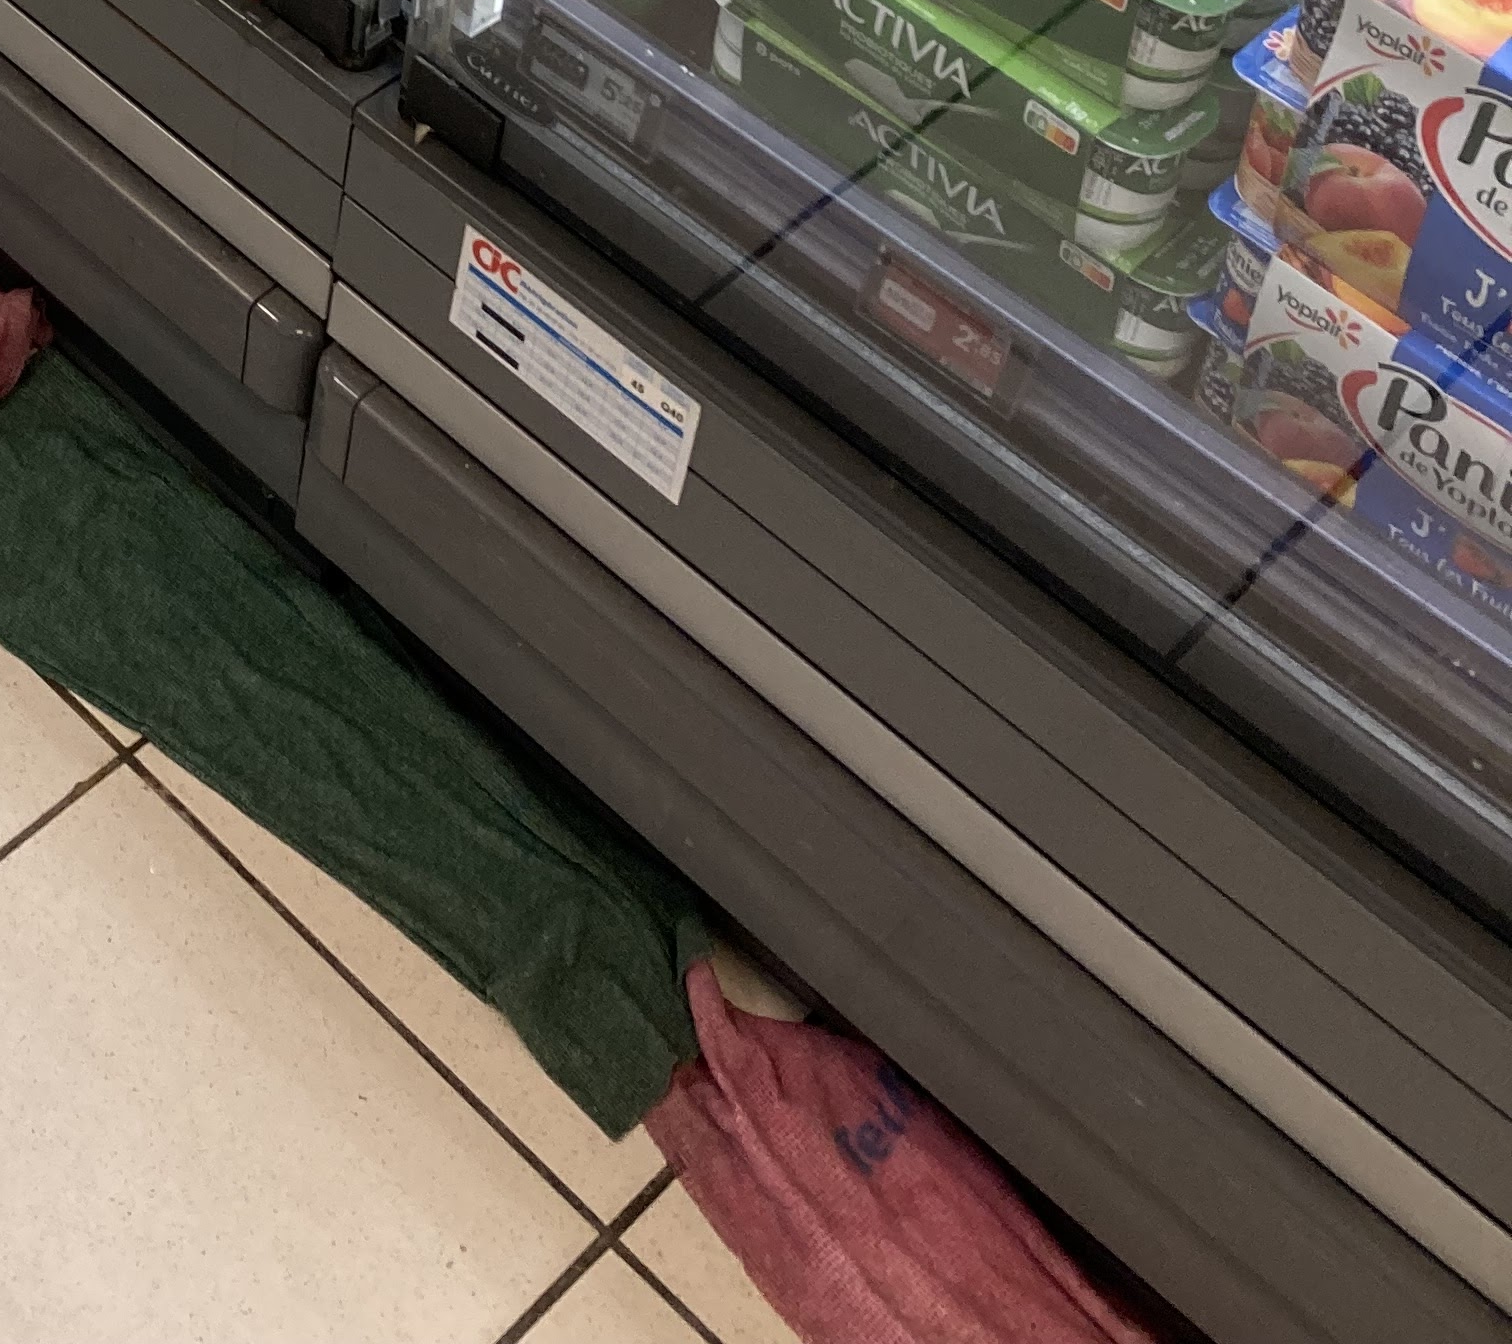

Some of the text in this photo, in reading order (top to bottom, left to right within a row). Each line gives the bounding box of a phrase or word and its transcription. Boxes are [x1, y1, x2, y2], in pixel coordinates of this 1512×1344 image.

[1355, 14, 1427, 67] Yoplait
[848, 108, 1007, 235] ACTIVIA
[1476, 186, 1509, 216] de
[1275, 283, 1344, 339] Yoplait
[1398, 450, 1512, 535] de Yopla
